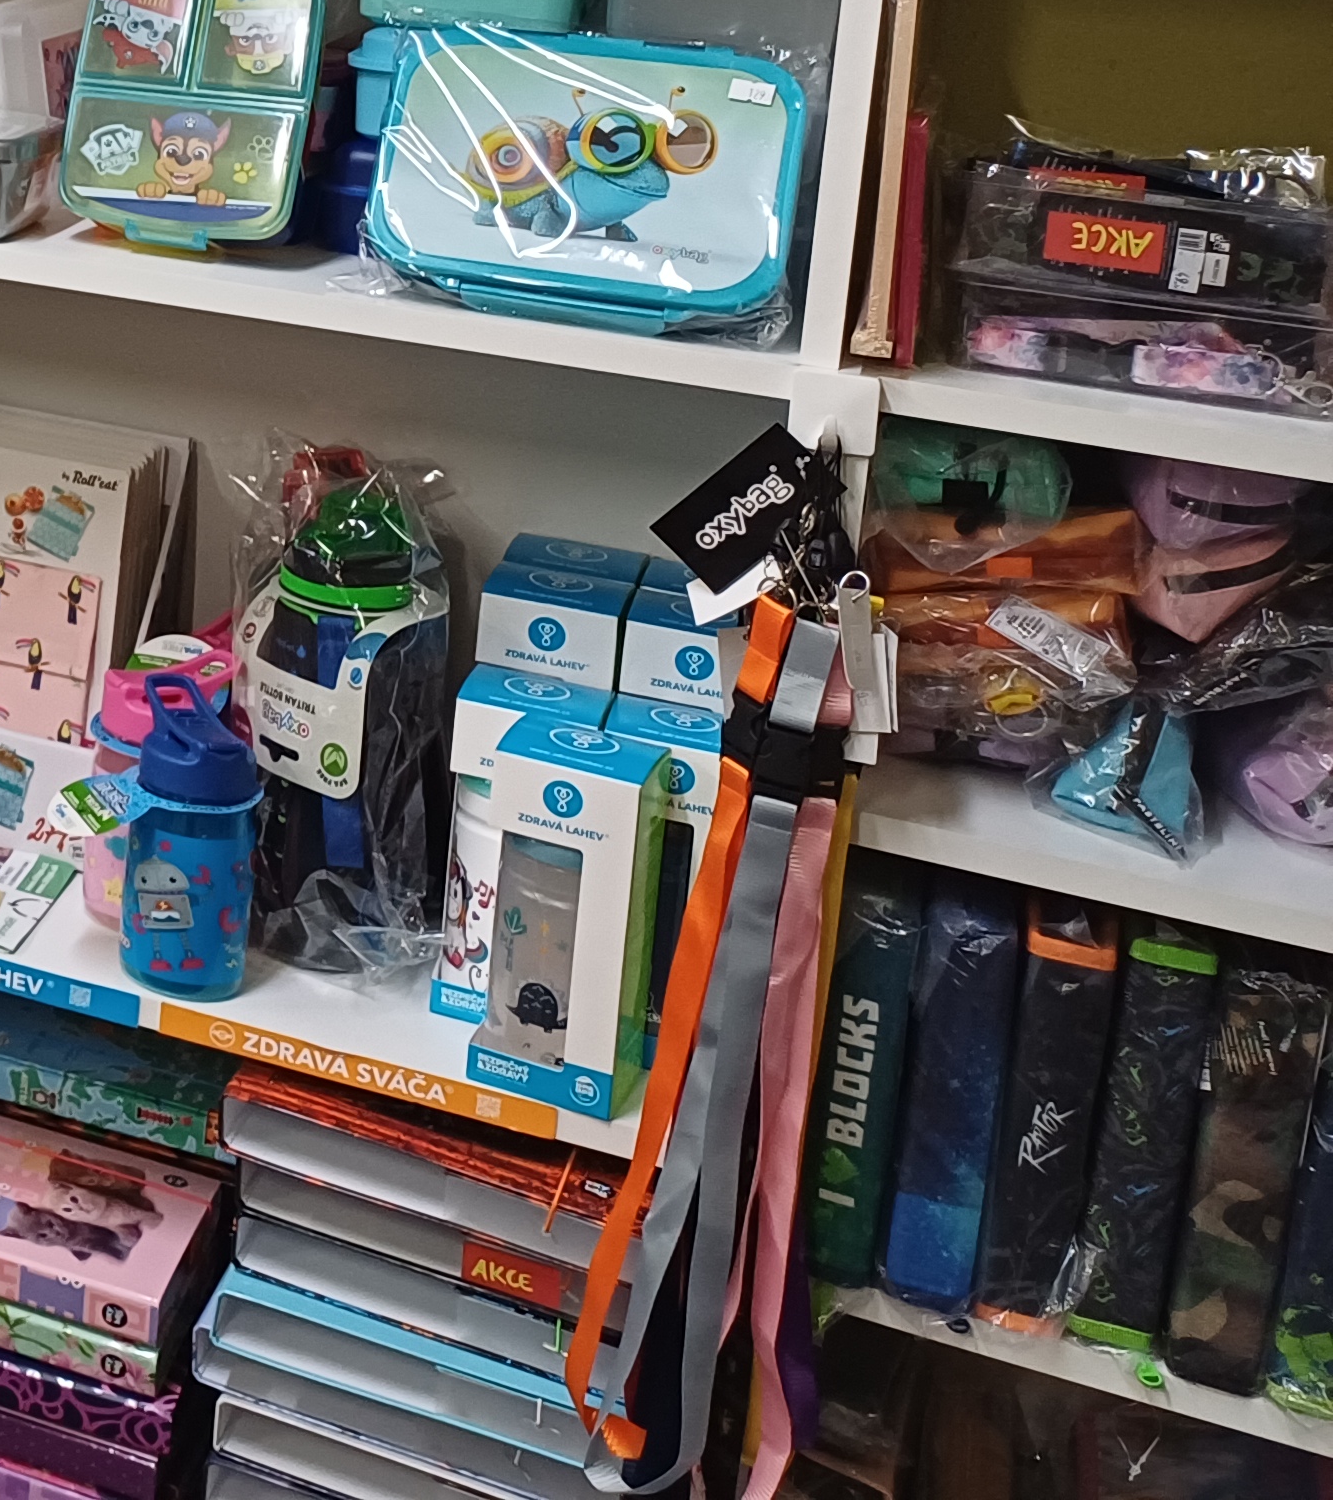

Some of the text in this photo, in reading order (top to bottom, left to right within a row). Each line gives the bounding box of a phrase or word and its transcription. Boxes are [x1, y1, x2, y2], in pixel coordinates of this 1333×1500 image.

[1070, 220, 1154, 259] AKCE
[696, 468, 794, 549] oxybag
[505, 649, 586, 671] ZDRAVÁ LAHEV
[259, 681, 316, 716] TRITAN BOTTLE
[650, 676, 695, 695] ZDRAVÁ
[518, 812, 604, 841] ZDRAVÁ LAHEV
[243, 1030, 447, 1106] ZDRAVÁ SVÁČA
[826, 994, 880, 1149] BLOCKS
[471, 1259, 534, 1292] AKCE
